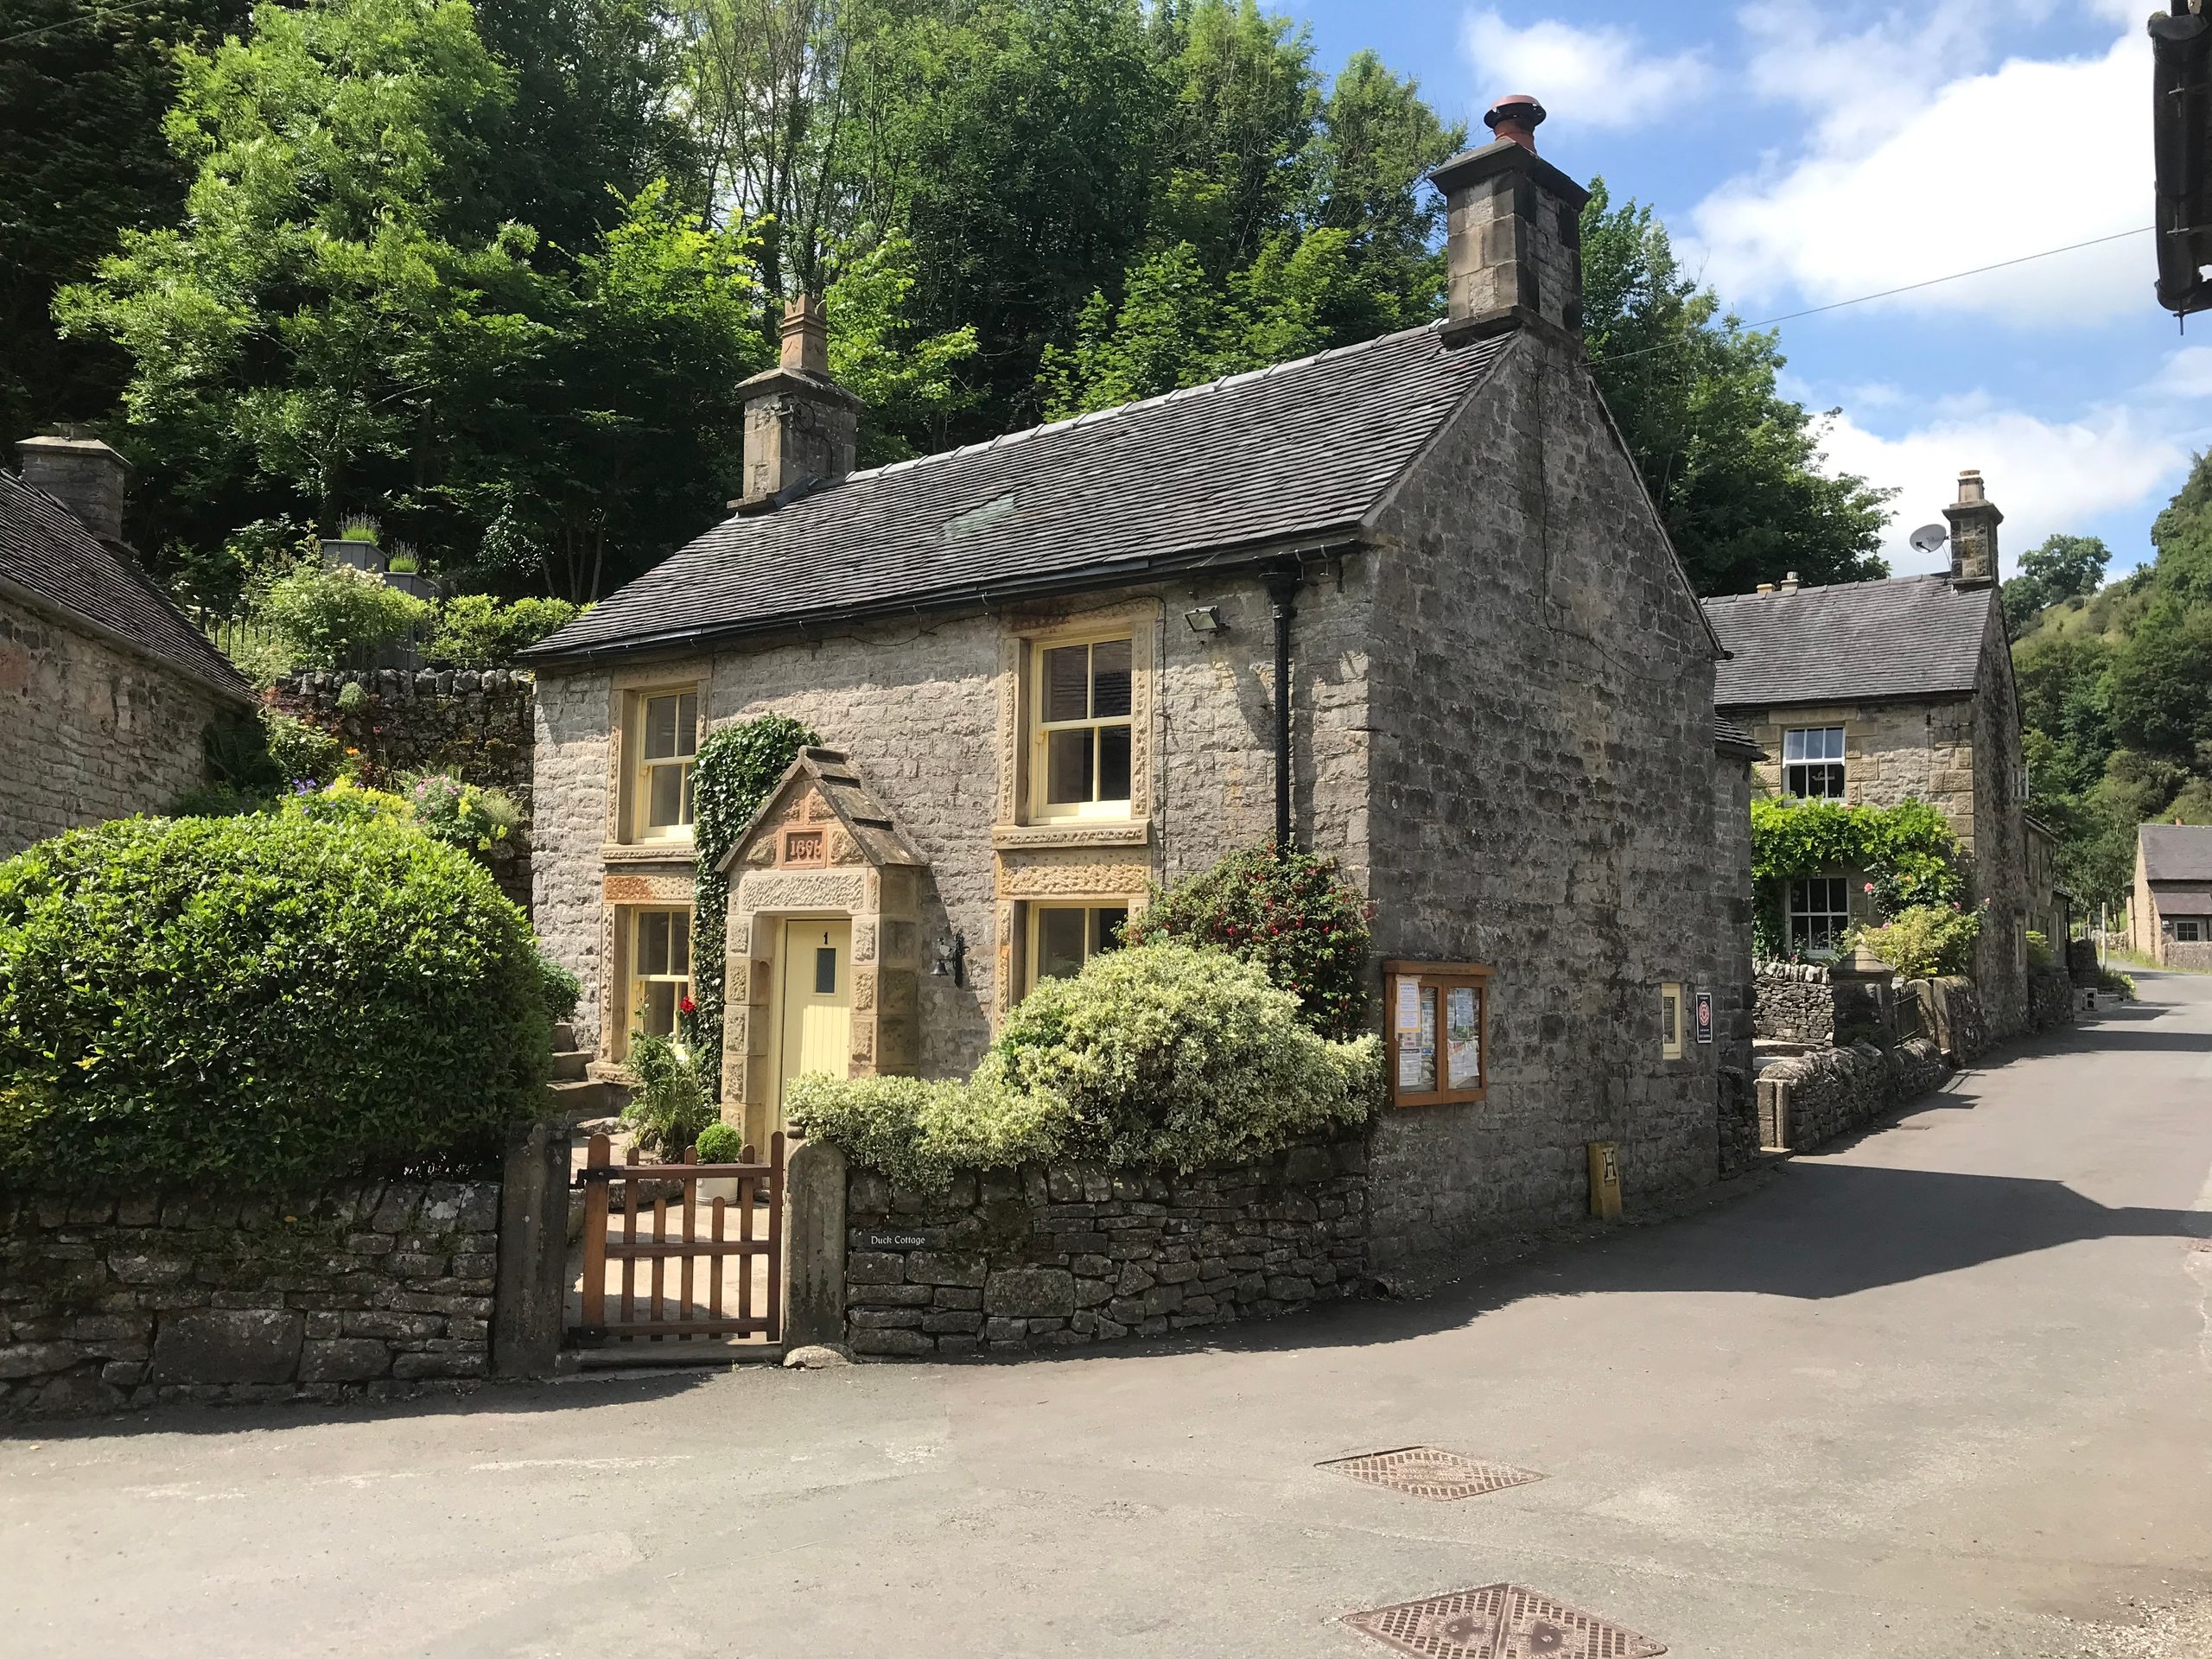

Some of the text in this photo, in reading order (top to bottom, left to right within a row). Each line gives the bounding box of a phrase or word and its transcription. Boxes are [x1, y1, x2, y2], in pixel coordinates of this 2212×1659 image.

[823, 931, 829, 945] 1
[871, 1235, 926, 1246] Duck Cottage
